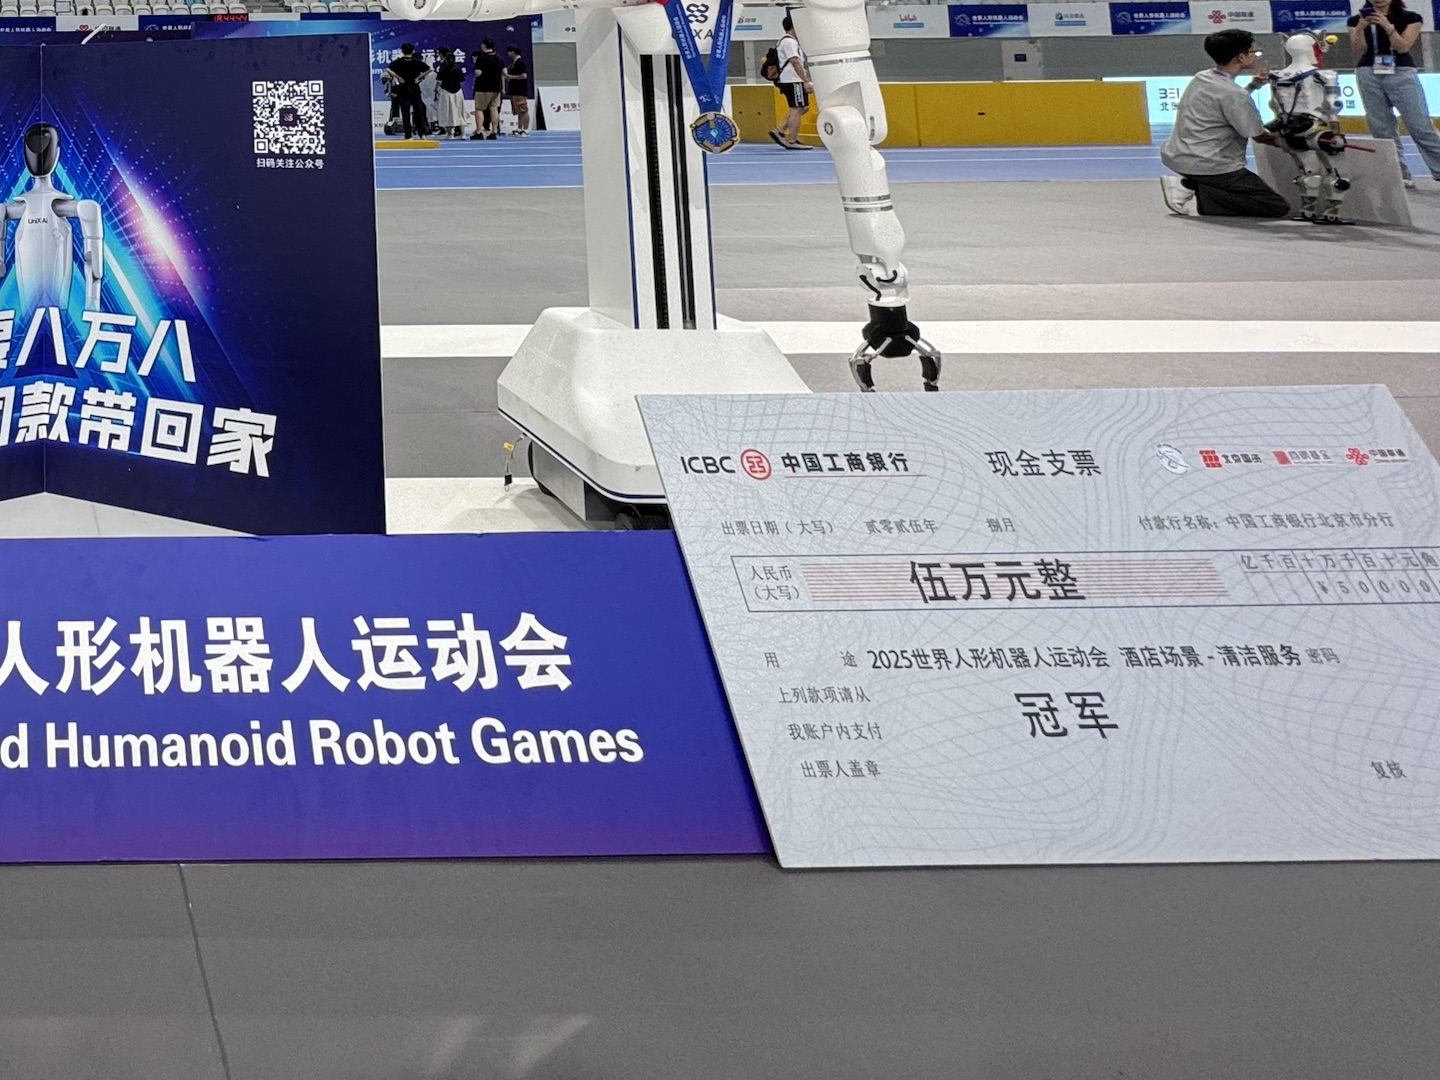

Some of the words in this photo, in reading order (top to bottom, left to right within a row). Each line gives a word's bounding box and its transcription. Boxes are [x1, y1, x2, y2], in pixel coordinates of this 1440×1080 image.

[256, 157, 325, 170] 扫码关注公众号
[680, 455, 736, 475] ICBC
[983, 448, 1103, 478] 现金支票
[750, 565, 793, 582] 人民币
[909, 557, 1087, 605] 伍万元整
[866, 645, 1111, 670] 2025世界人形机器人运动会
[778, 686, 872, 705] 上列款项请从
[1013, 691, 1120, 739] 冠军
[787, 721, 884, 741] 我账户内支付
[45, 719, 293, 769] Humanoid
[308, 718, 461, 766] Robot
[470, 716, 645, 765] Games
[800, 759, 882, 778] 出票人盖章
[1369, 760, 1408, 780] 复核
